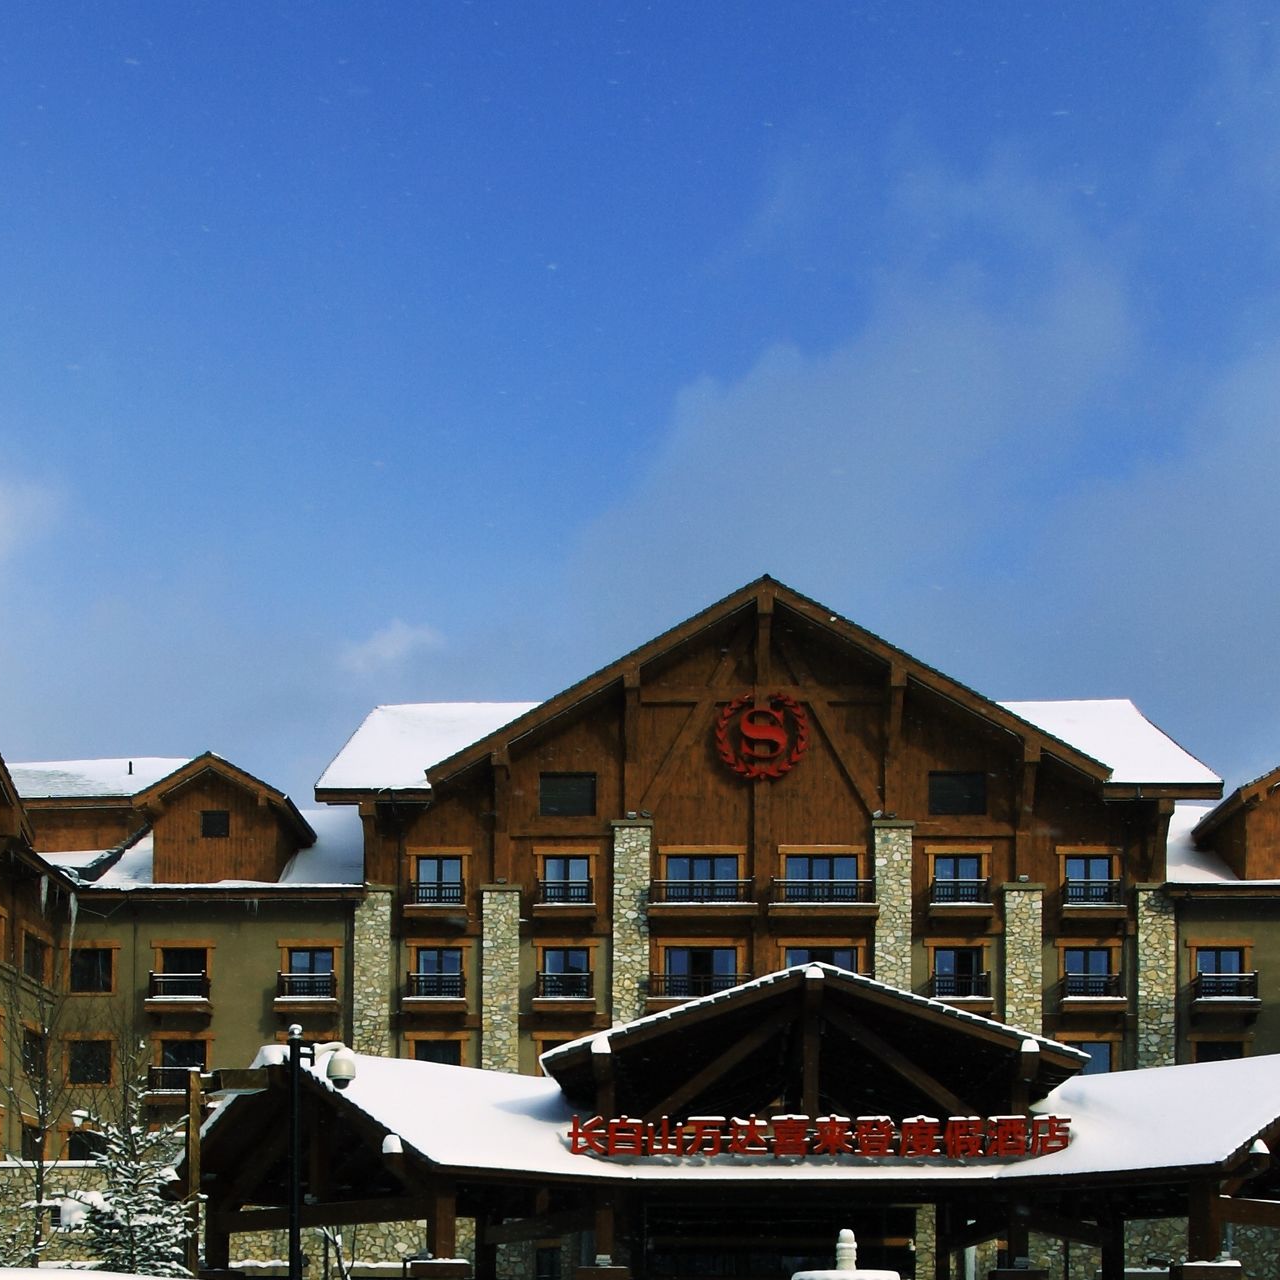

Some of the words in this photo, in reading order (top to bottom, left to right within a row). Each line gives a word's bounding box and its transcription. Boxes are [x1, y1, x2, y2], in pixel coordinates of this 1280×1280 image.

[740, 708, 788, 759] S
[567, 1113, 1072, 1159] 长白山万达喜来登度假酒店
